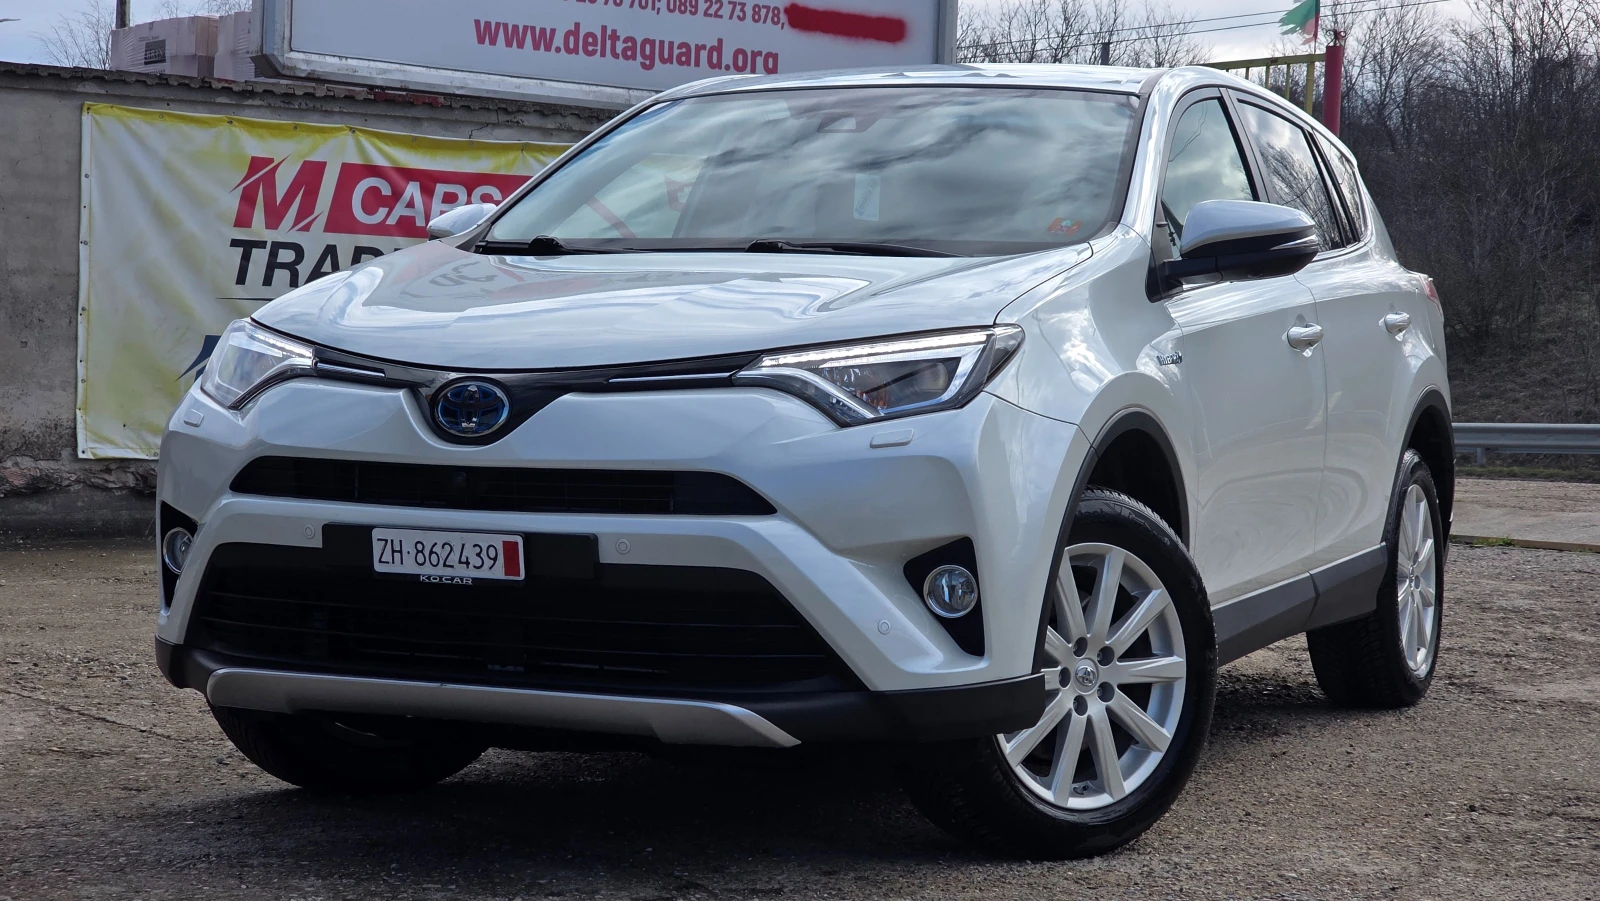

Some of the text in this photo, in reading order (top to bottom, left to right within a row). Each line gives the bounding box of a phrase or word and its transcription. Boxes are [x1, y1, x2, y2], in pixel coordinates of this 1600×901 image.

[666, 0, 699, 16] 089
[703, 0, 724, 19] 22
[728, 1, 747, 22] 73
[751, 3, 785, 30] 878,
[474, 19, 779, 75] www.deltaguard.org
[229, 153, 327, 233] M
